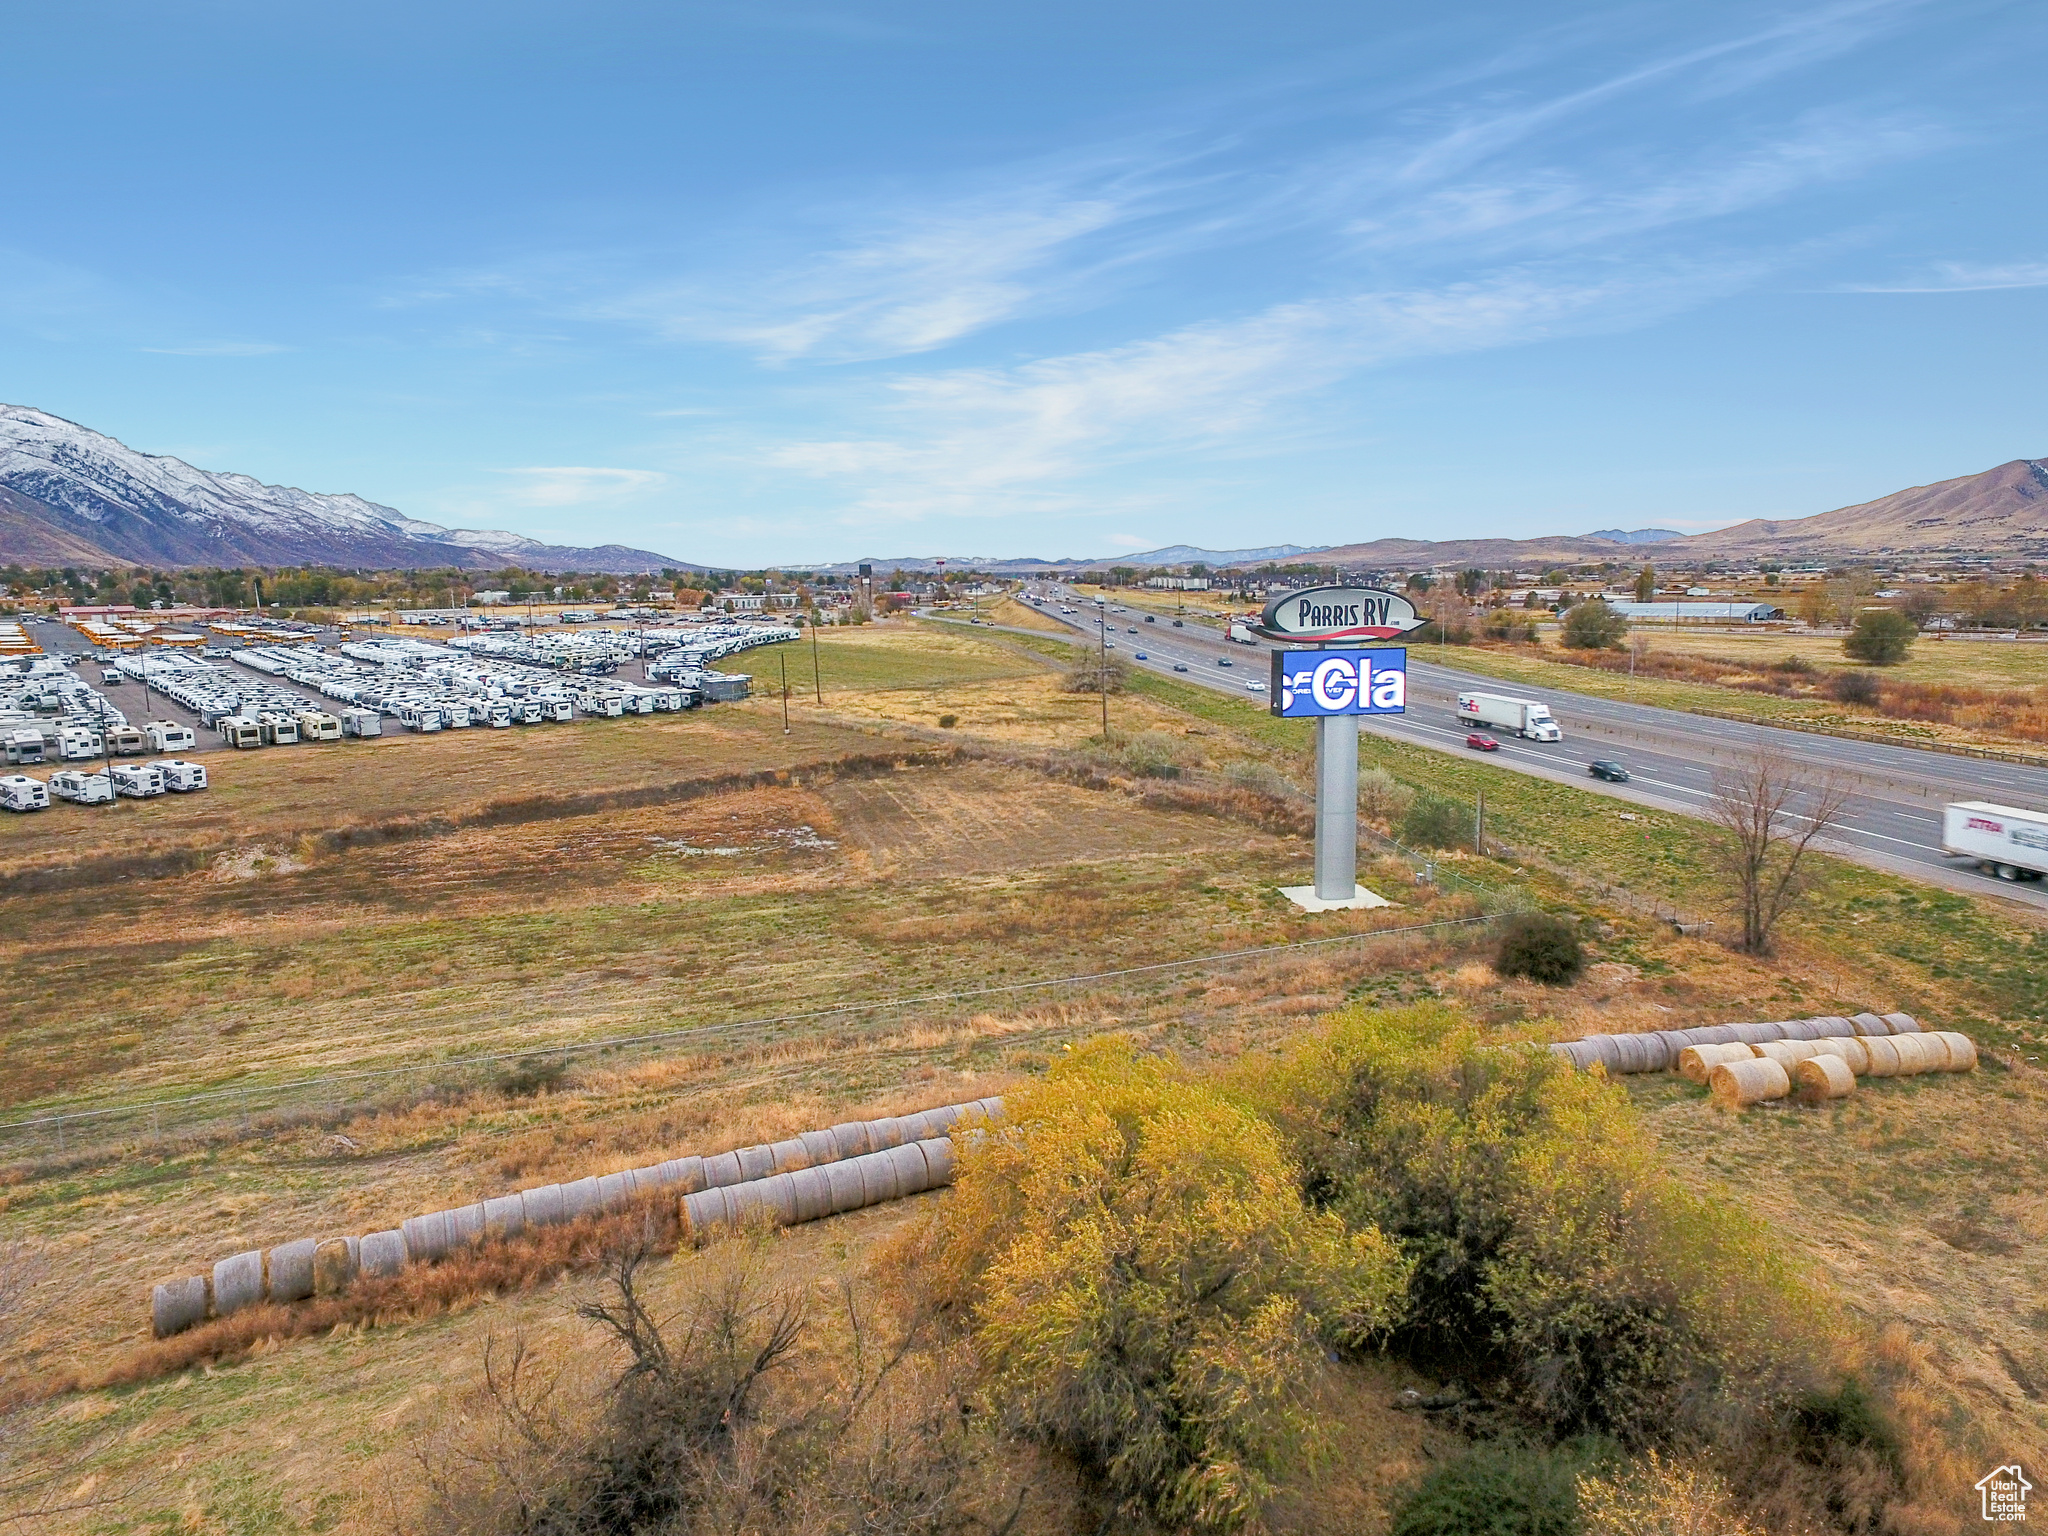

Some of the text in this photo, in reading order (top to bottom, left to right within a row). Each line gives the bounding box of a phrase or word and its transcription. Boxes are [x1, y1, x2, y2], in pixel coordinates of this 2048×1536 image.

[1364, 598, 1390, 626] RV
[1312, 658, 1405, 710] Cla
[1460, 698, 1480, 712] FedEx
